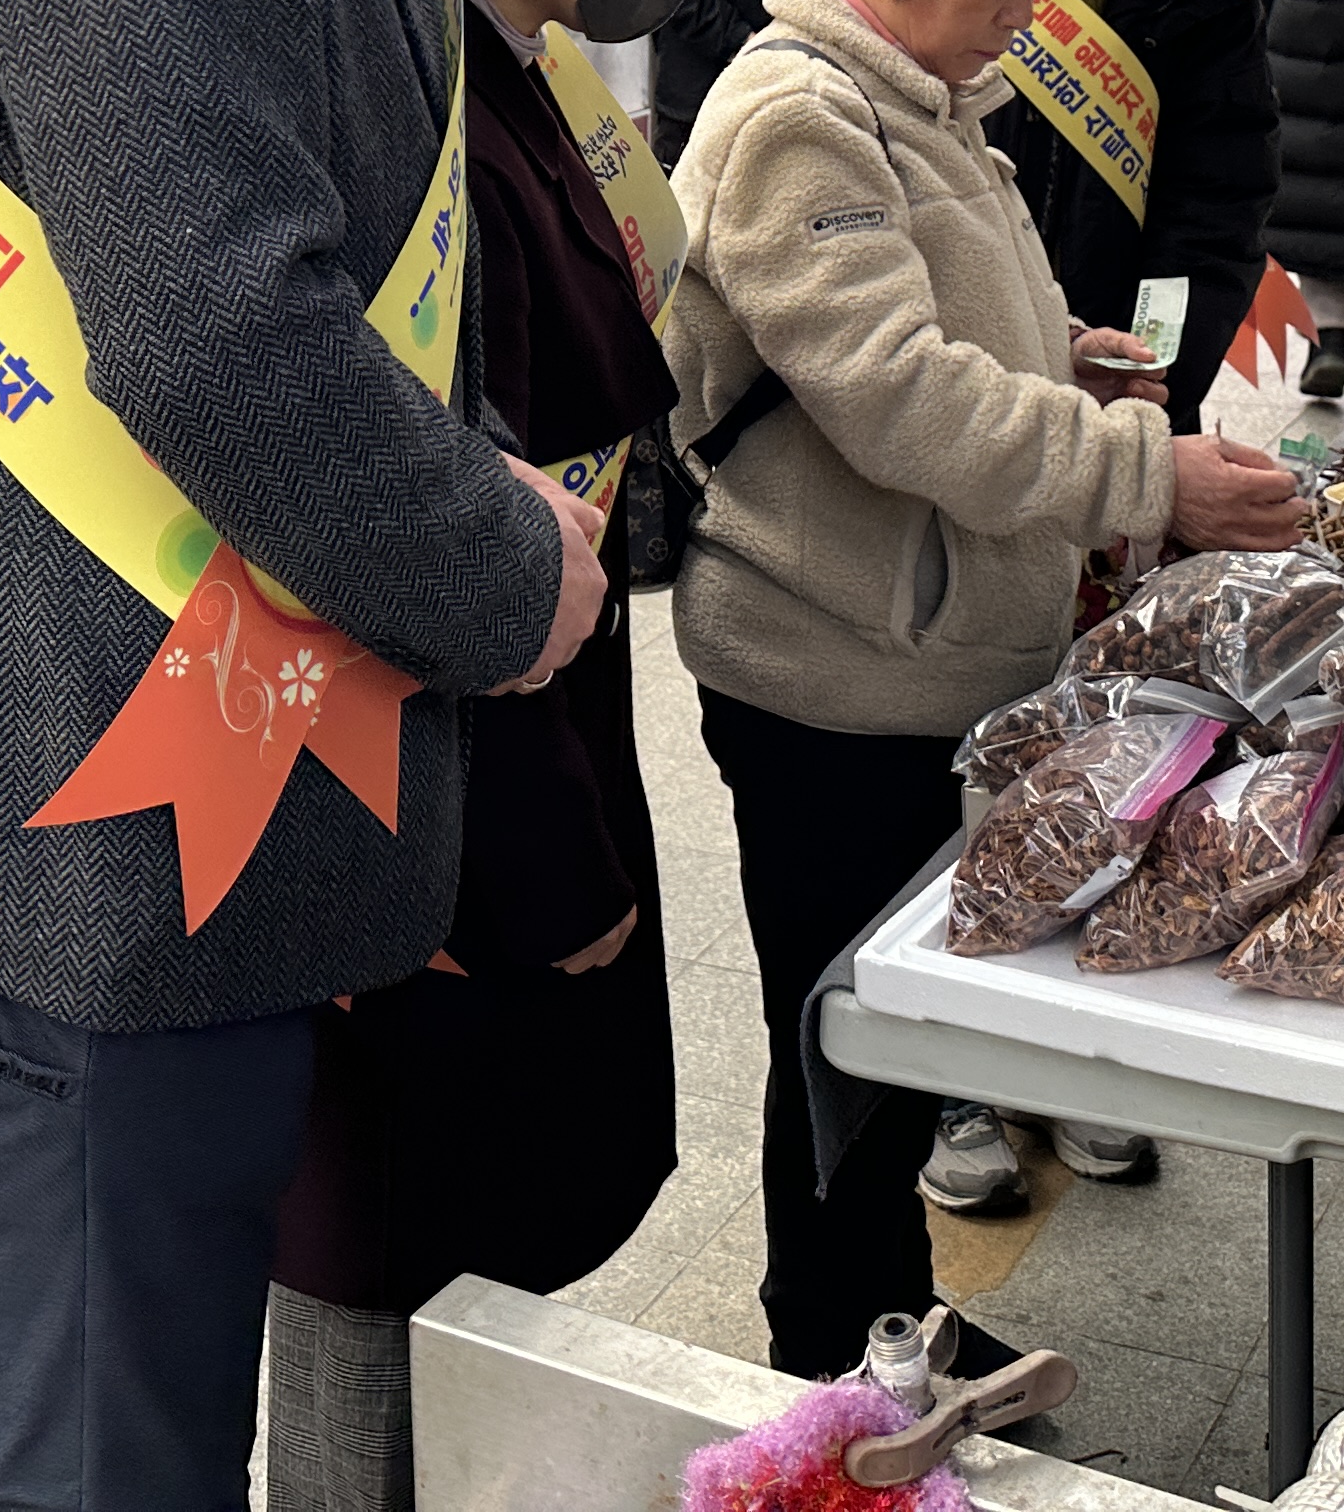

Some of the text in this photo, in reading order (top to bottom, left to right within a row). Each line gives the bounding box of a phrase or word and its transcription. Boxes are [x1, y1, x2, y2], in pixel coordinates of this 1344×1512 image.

[1007, 28, 1146, 184] 안전한 식탁의
[1074, 36, 1146, 122] 원산지
[814, 208, 886, 231] Discovery
[1135, 284, 1152, 330] 10000
